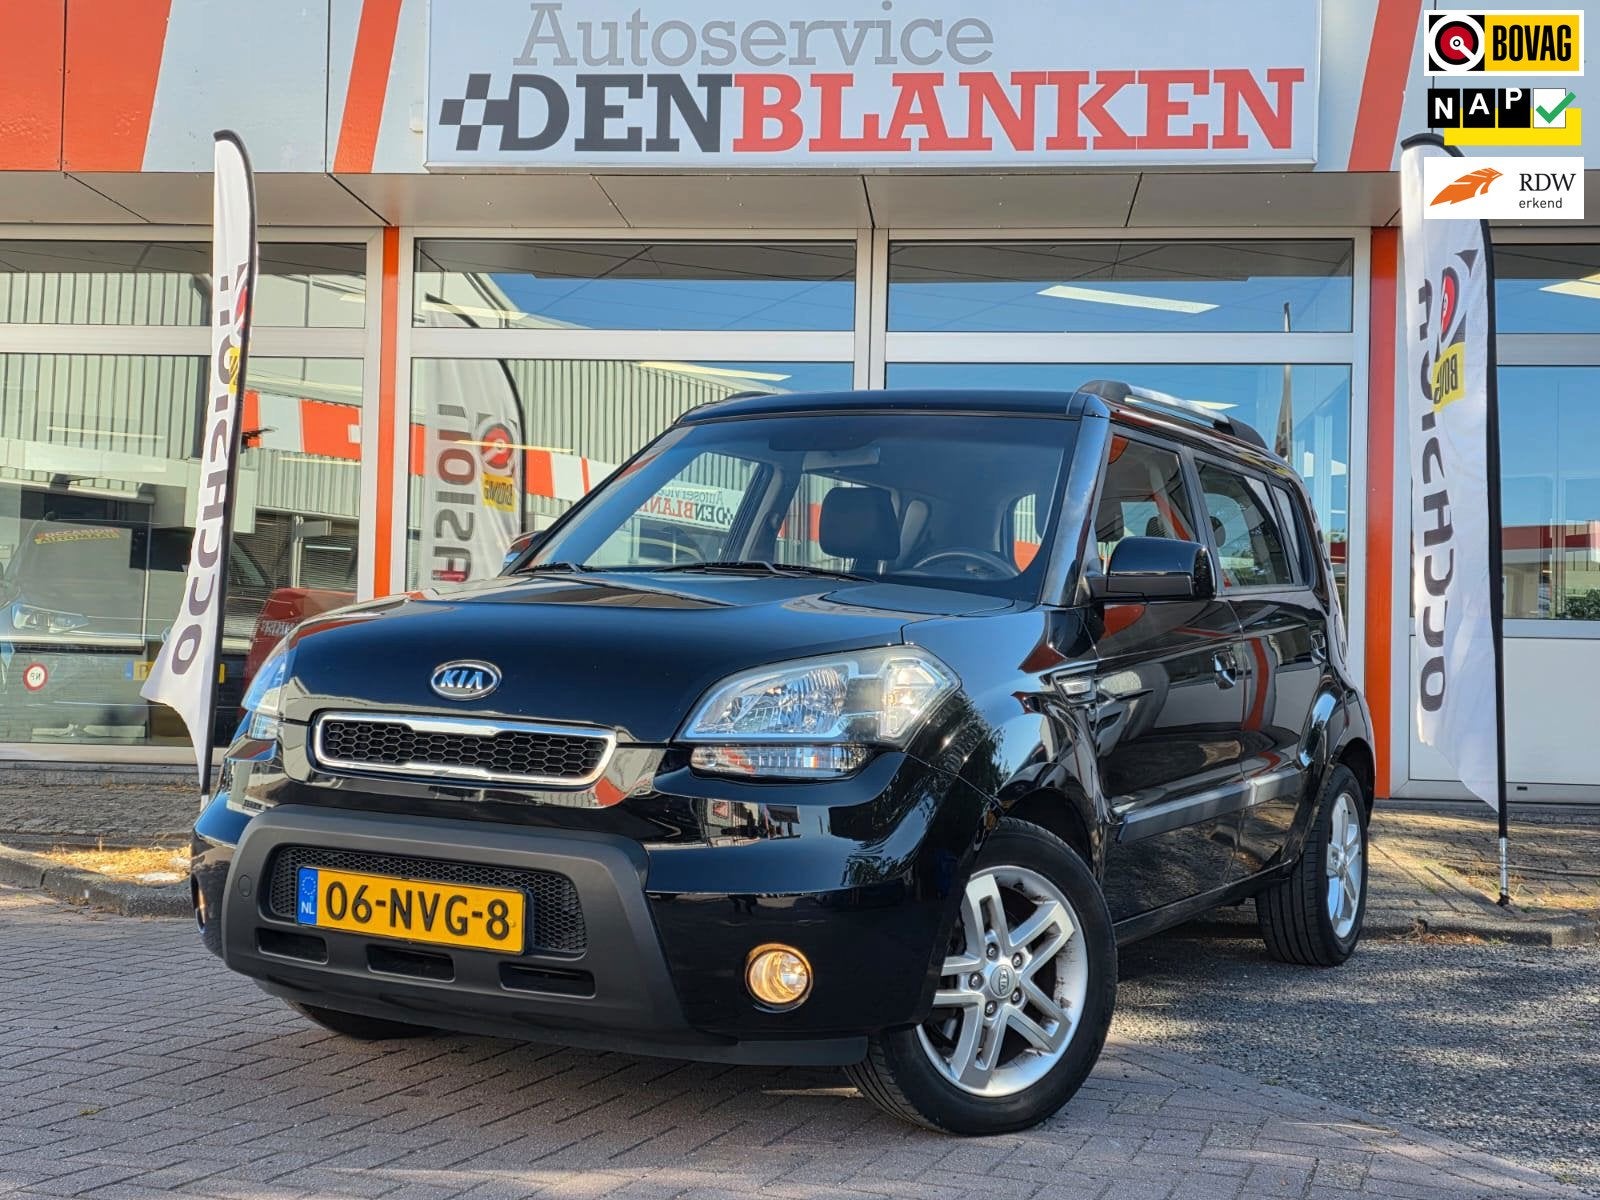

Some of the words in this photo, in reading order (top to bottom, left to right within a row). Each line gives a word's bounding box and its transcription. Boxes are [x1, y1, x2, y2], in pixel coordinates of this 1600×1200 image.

[512, 1, 993, 67] Autoservice
[440, 669, 484, 691] KIA
[301, 900, 316, 916] NL
[325, 880, 511, 942] 06-NVG-8
